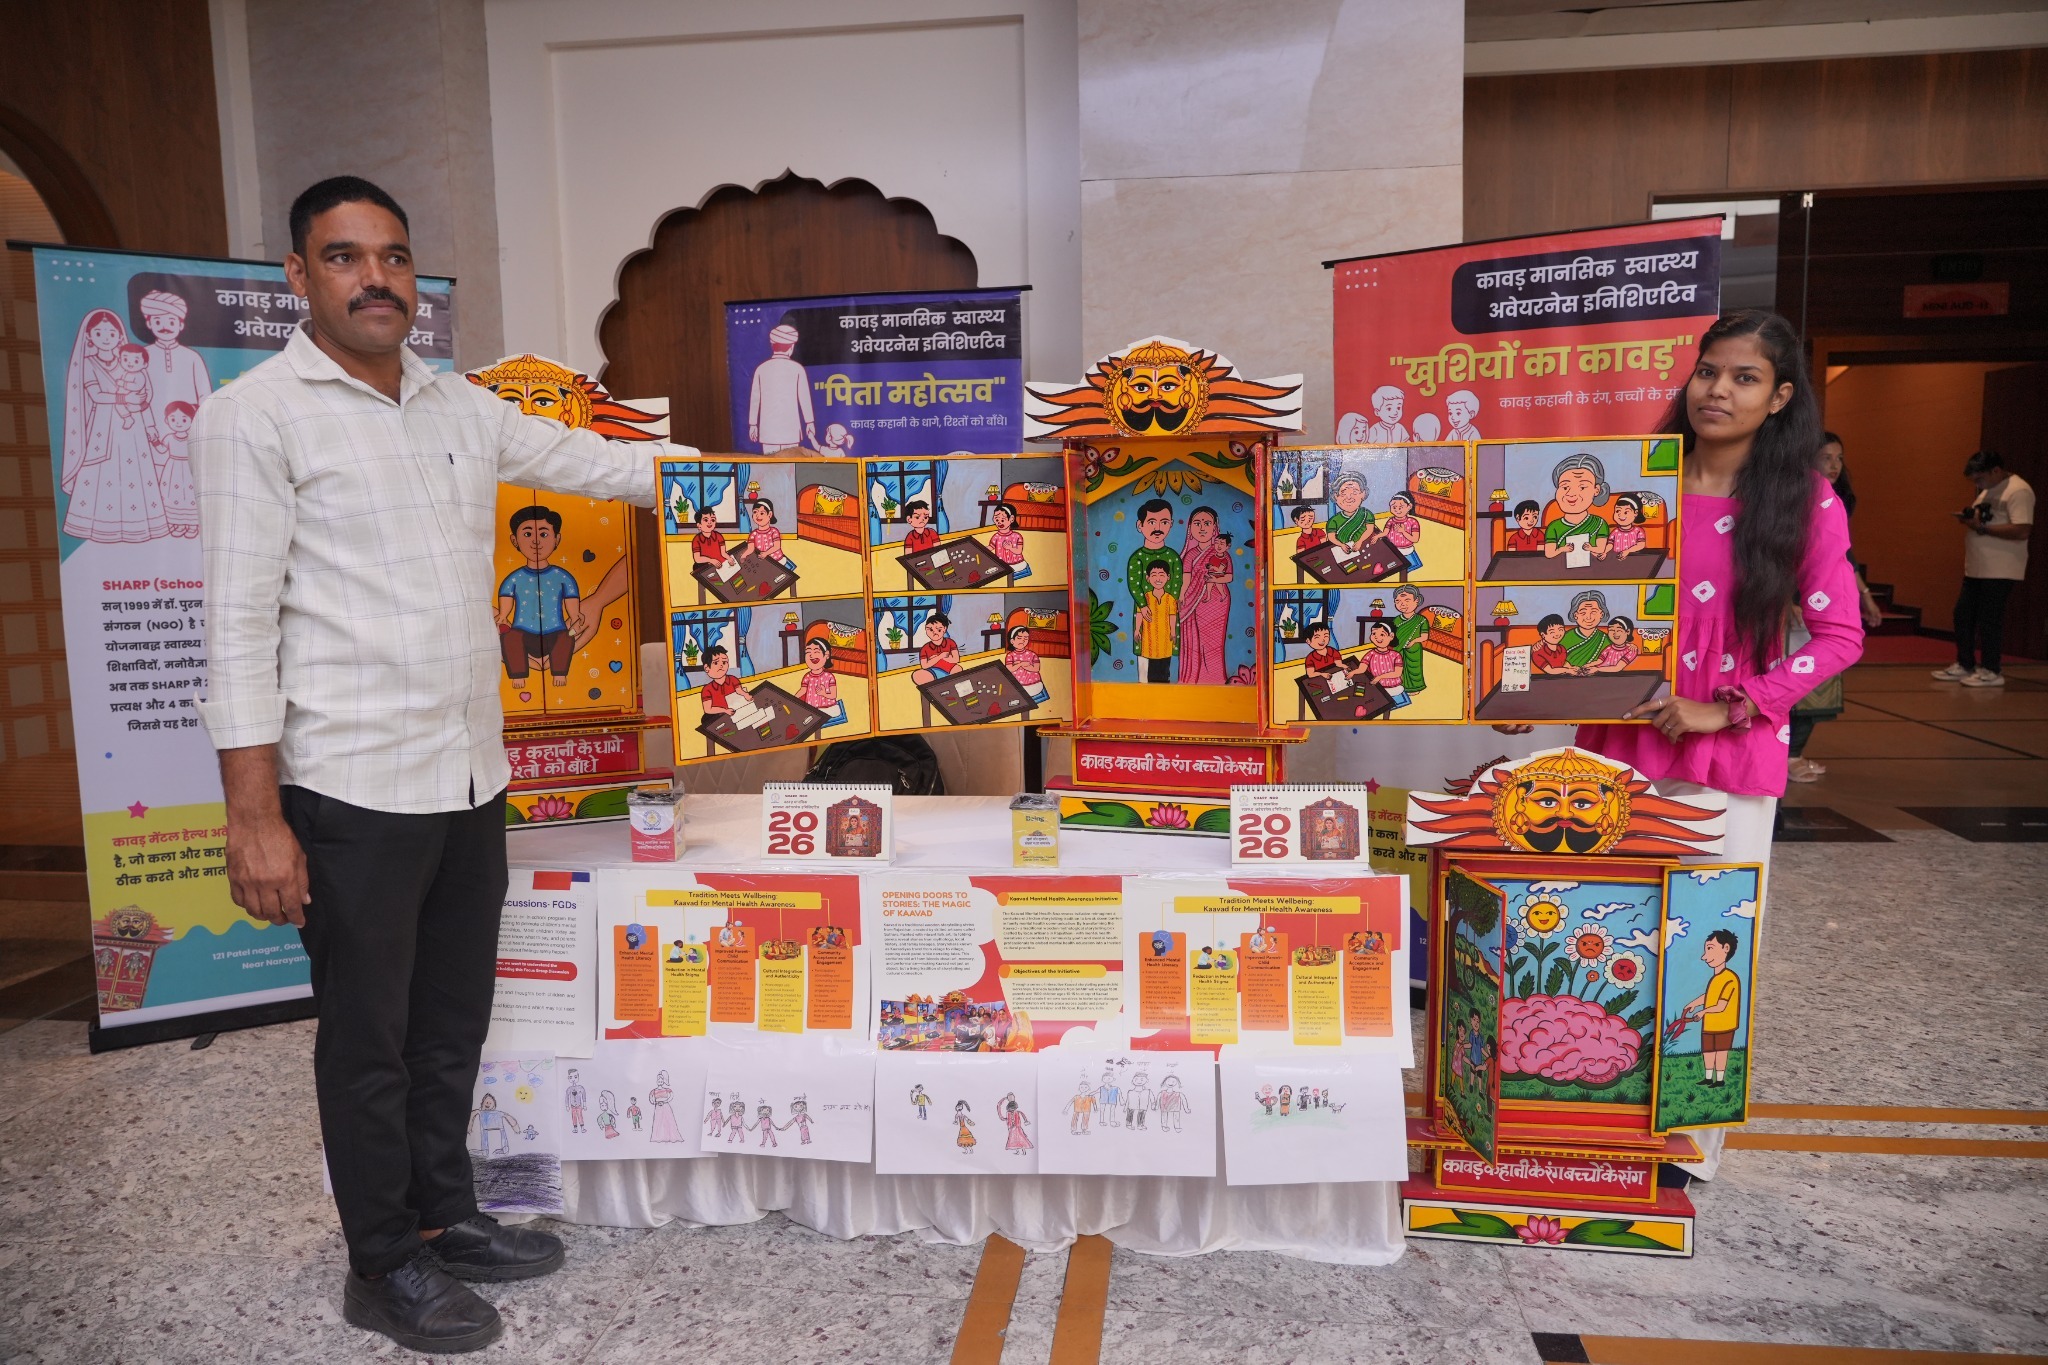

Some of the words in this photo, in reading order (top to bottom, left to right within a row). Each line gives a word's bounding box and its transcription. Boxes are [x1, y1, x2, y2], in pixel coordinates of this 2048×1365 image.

[1475, 269, 1526, 291] कावड़
[1529, 256, 1616, 284] मानसिक
[1624, 250, 1699, 276] स्वास्थ्य
[215, 289, 271, 313] कावड़
[1489, 292, 1579, 319] अवेयरनेस
[1582, 280, 1697, 314] इनिशिएटिव
[839, 314, 879, 332] कावड़
[881, 308, 946, 328] मानसिक
[952, 309, 1006, 325] स्वास्थ्य
[851, 334, 920, 353] अवेयरनेस
[922, 330, 1006, 352] इनिशिएटिव
[1523, 347, 1572, 377] का
[1499, 396, 1533, 410] कावड़
[1535, 391, 1574, 408] कहानी
[1576, 390, 1590, 405] के
[1614, 387, 1646, 403] बच्चों
[1648, 387, 1662, 401] के
[1665, 387, 1682, 400] सं
[850, 419, 876, 431] कावड़
[877, 416, 907, 429] कहानी
[909, 416, 920, 428] के
[970, 415, 984, 426] को
[103, 581, 150, 590] SHARP
[154, 577, 203, 592] (Schoo
[101, 602, 123, 613] सन्
[124, 602, 150, 610] 1999
[151, 598, 163, 609] में
[103, 620, 141, 631] संगठन
[147, 619, 183, 632] (NGO)
[188, 617, 196, 629] है
[105, 640, 160, 651] योजनाबद्ध
[164, 640, 201, 650] स्वास्थ्य
[164, 657, 207, 669] मनोवैज्ञा
[109, 683, 127, 692] अब
[129, 681, 149, 691] तक
[152, 680, 190, 690] SHARP
[192, 677, 202, 687] ने
[110, 702, 142, 712] प्रत्यक्ष
[146, 698, 165, 710] और
[168, 700, 176, 708] 4
[127, 719, 161, 731] जिससे
[181, 717, 198, 727] देश
[525, 739, 577, 762] कहानी
[577, 739, 592, 754] के
[544, 758, 566, 774] को
[1080, 754, 1115, 773] कावड़
[1114, 752, 1156, 774] कहानी
[1156, 753, 1171, 771] के
[1171, 754, 1193, 773] रंग
[1225, 755, 1240, 773] के
[1238, 757, 1265, 776] संग
[769, 811, 818, 832] 20
[1239, 813, 1291, 835] 20
[1378, 809, 1402, 821] मेंटल
[112, 835, 146, 847] कावड़
[148, 831, 180, 844] मेंटल
[182, 828, 208, 841] हेल्थ
[768, 833, 814, 855] 26
[1376, 829, 1398, 840] कला
[128, 852, 145, 865] जो
[147, 851, 176, 863] कला
[180, 846, 200, 859] और
[1239, 836, 1288, 858] 26
[1373, 846, 1395, 858] करते
[1398, 848, 1415, 861] और
[115, 873, 142, 886] ठीक
[145, 869, 174, 883] करते
[179, 866, 199, 879] और
[503, 900, 550, 908] scussions-
[552, 900, 577, 909] FGDs
[212, 952, 225, 960] 121
[226, 949, 250, 958] Patel
[242, 961, 264, 969] Near
[266, 955, 306, 967] Narayan
[1442, 1159, 1485, 1180] कावड़
[1528, 1158, 1546, 1178] के
[1545, 1161, 1565, 1183] रंग
[1601, 1162, 1618, 1183] के
[1617, 1165, 1646, 1189] संग
